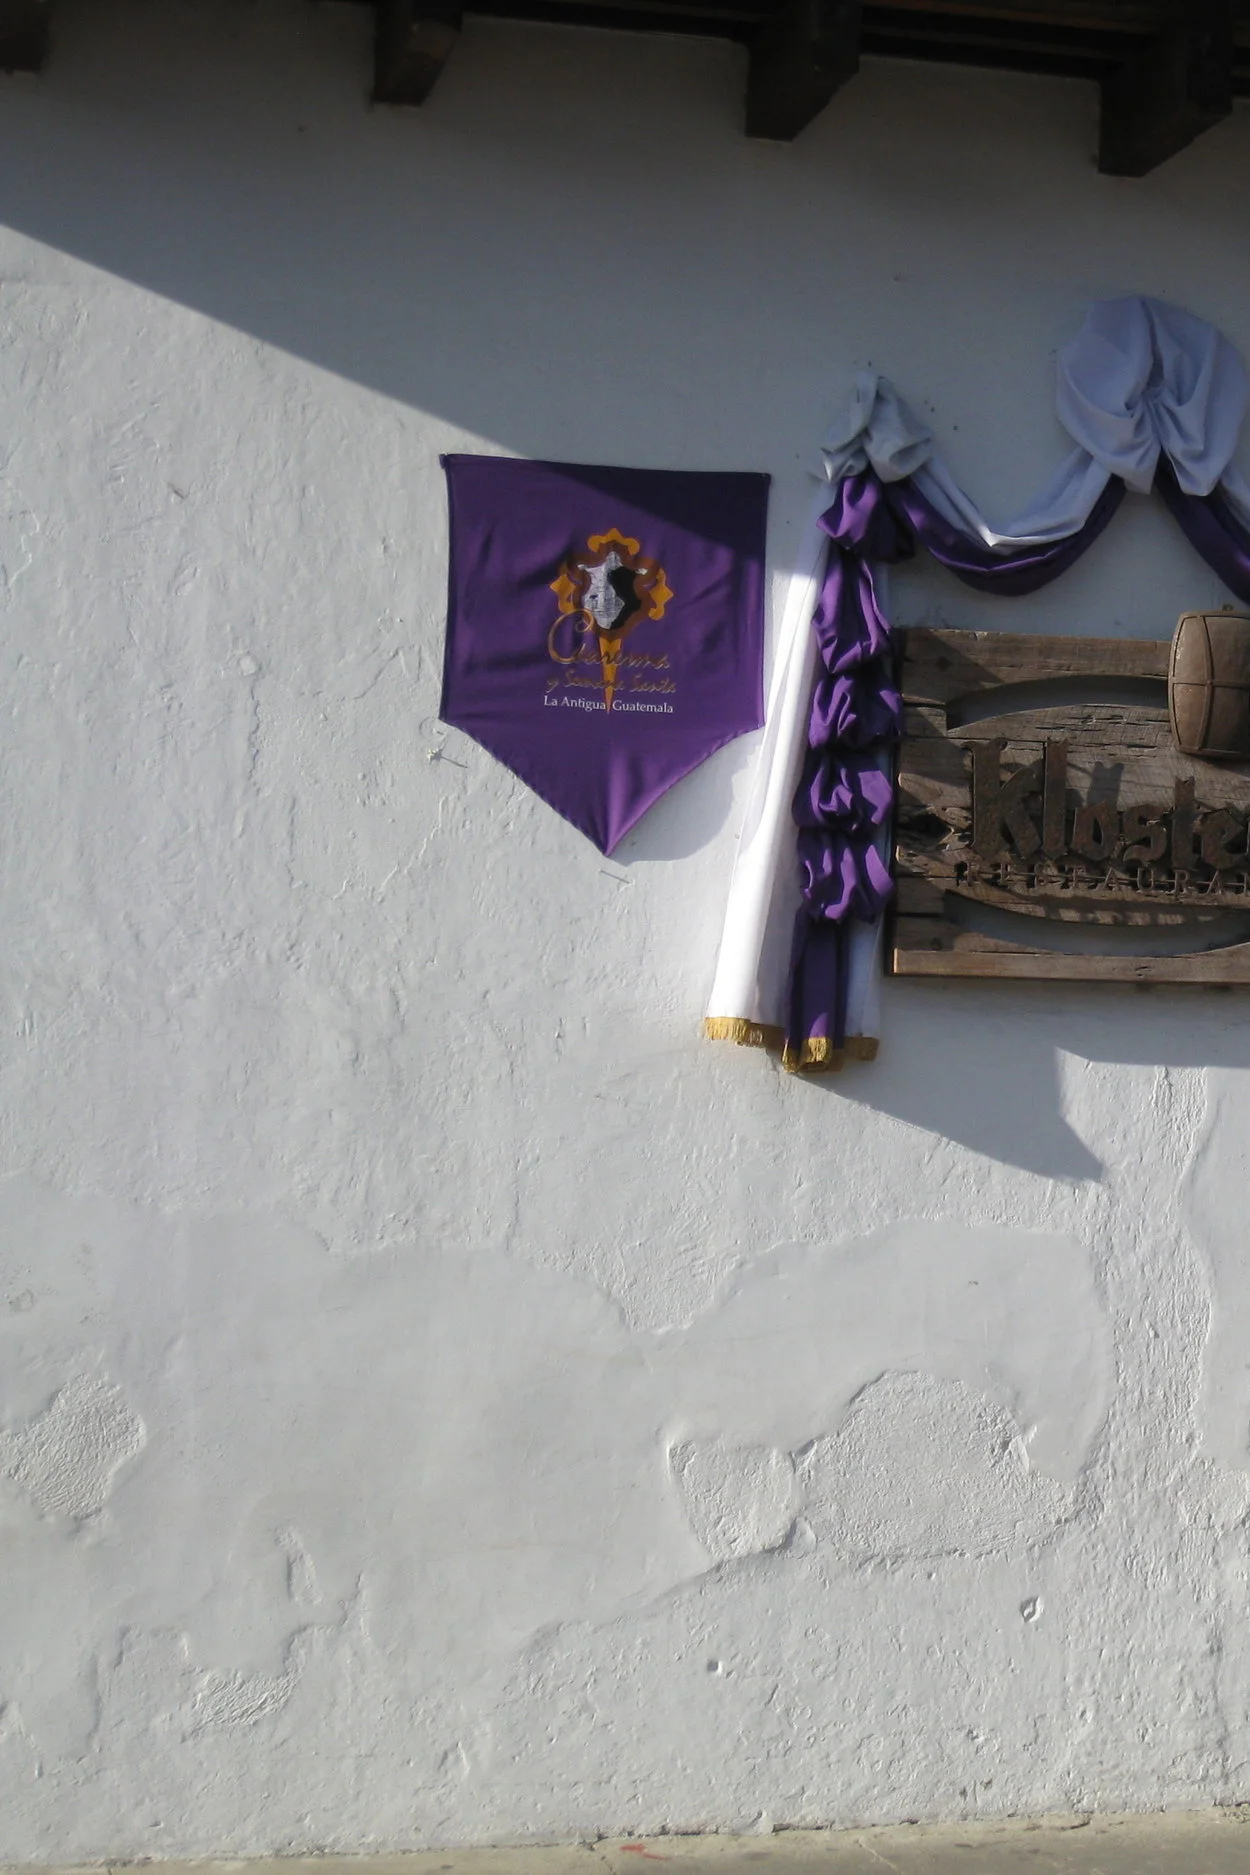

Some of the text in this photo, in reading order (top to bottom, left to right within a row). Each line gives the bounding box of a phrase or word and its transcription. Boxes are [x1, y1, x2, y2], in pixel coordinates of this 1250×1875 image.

[543, 695, 674, 714] La Antigua Guatemala
